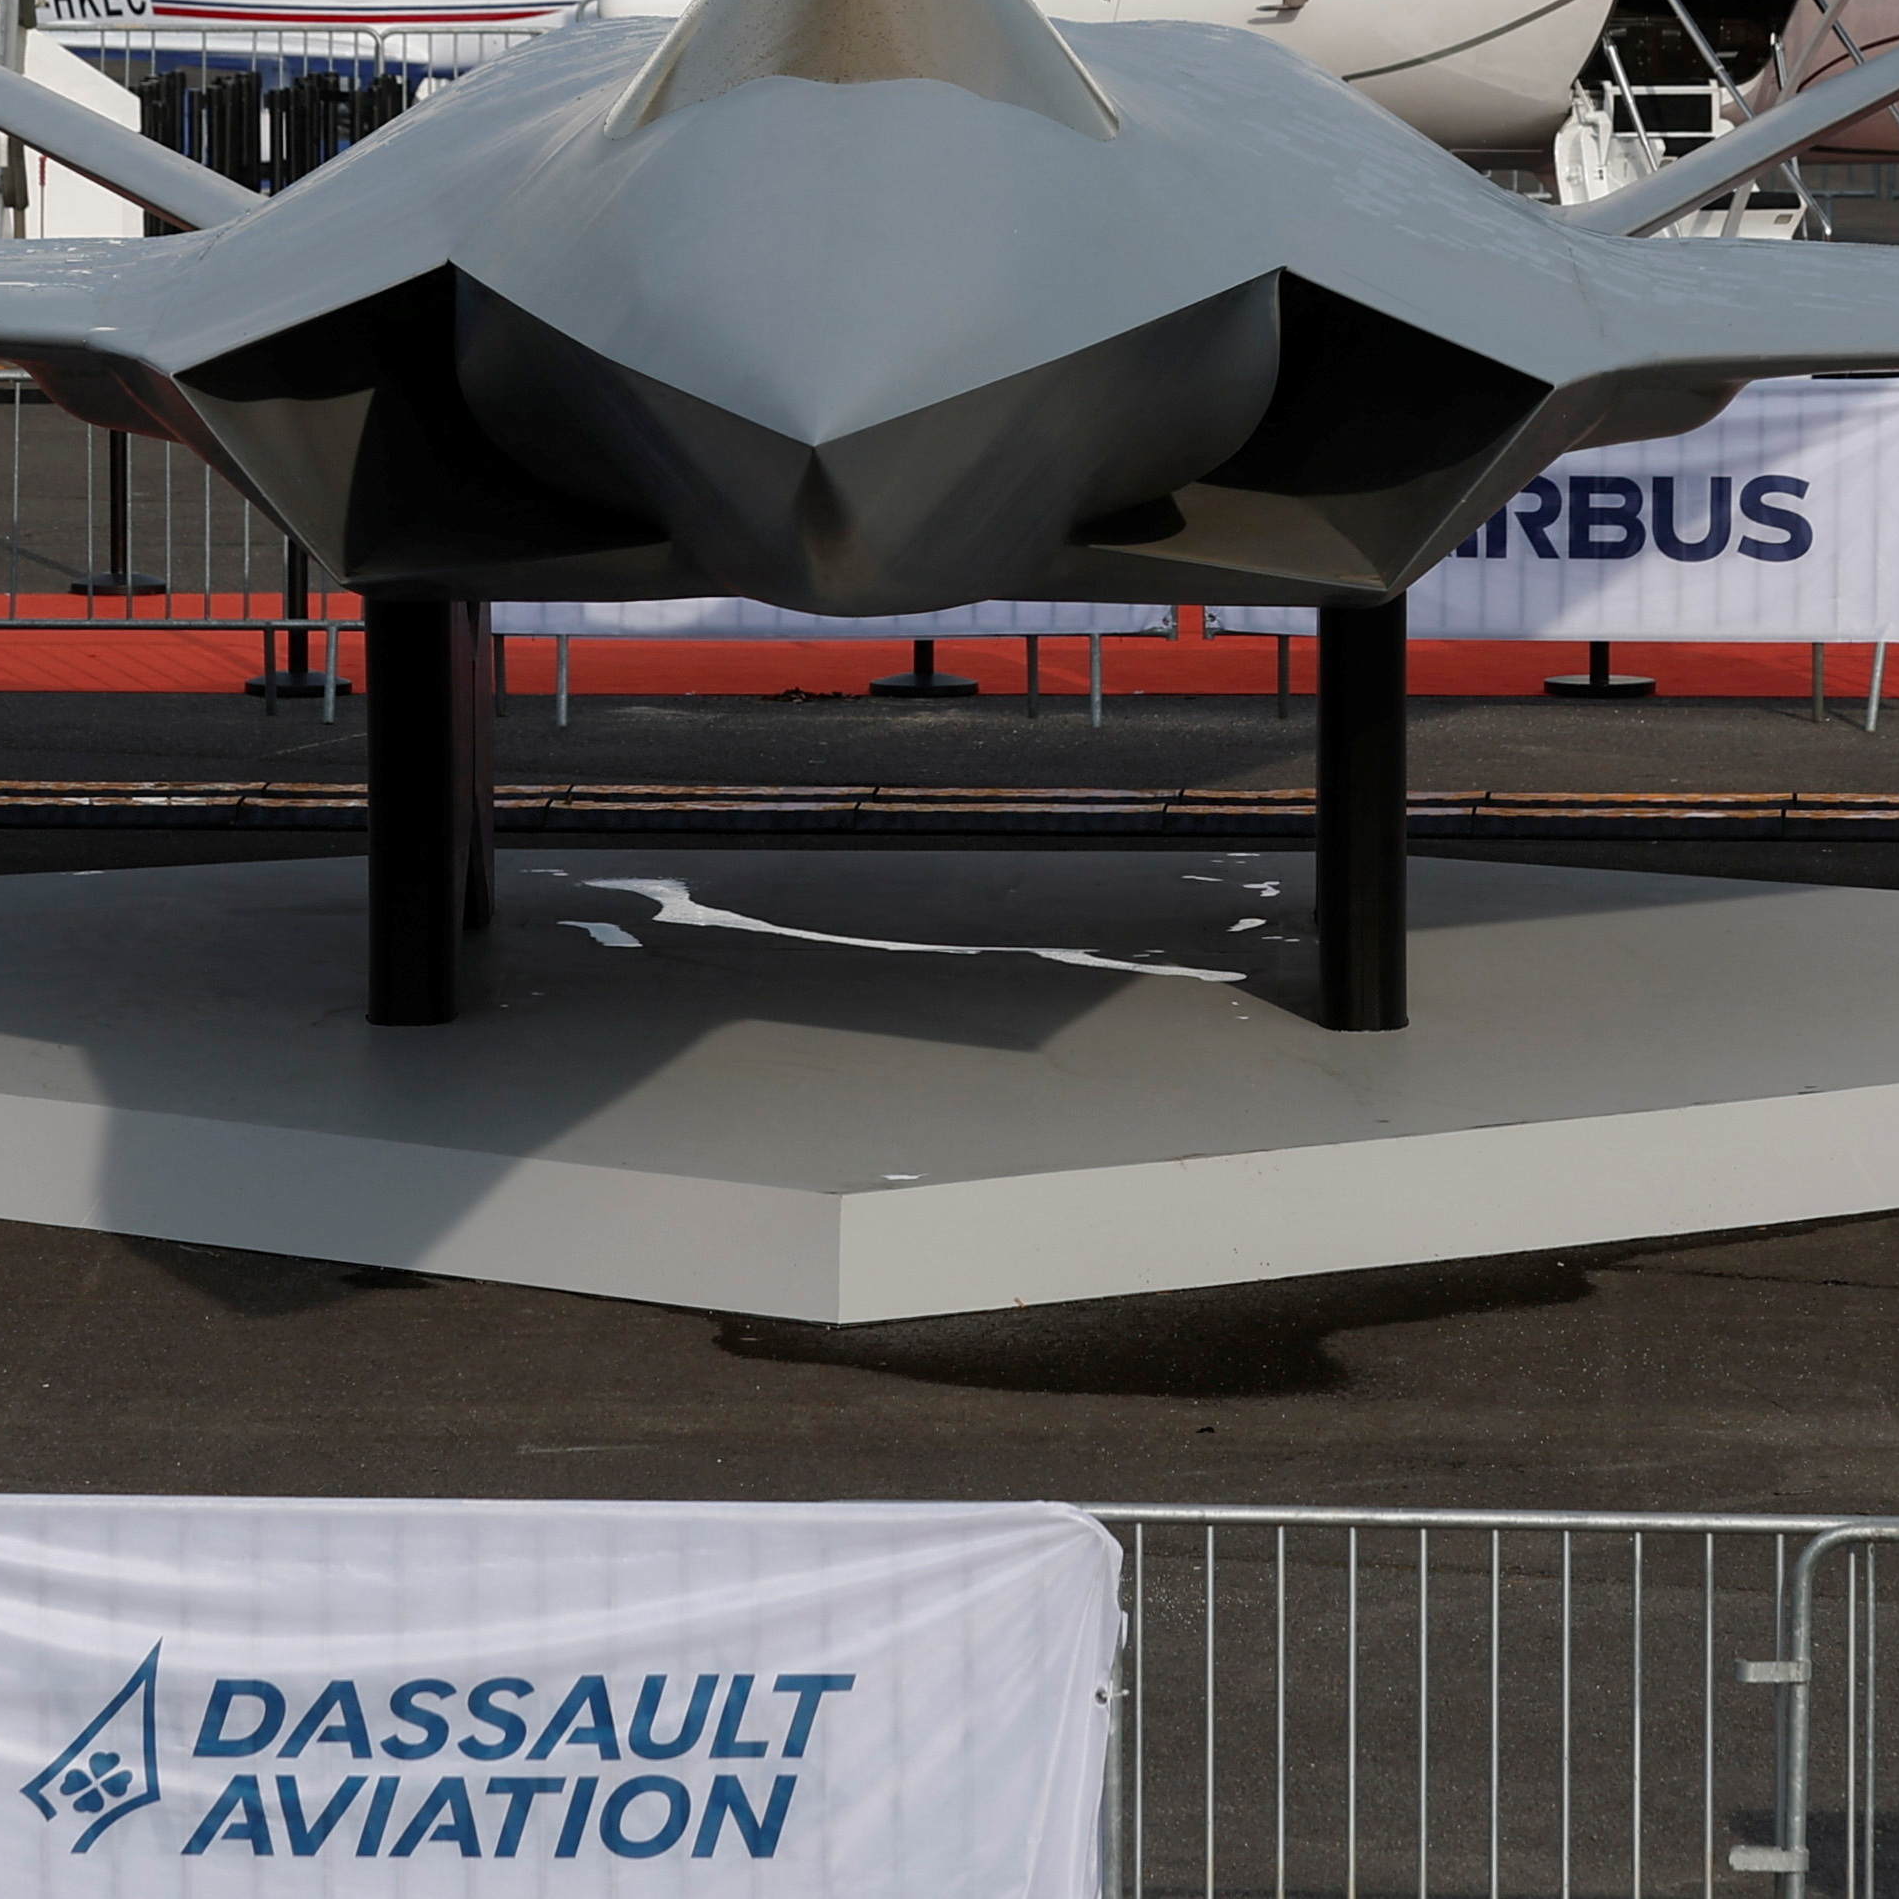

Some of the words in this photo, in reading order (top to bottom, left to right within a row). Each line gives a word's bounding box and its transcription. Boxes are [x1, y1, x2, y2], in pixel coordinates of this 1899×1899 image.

[1446, 474, 1814, 562] RBUS
[191, 1671, 854, 1761] DASSAULT
[181, 1773, 797, 1859] AVIATION
